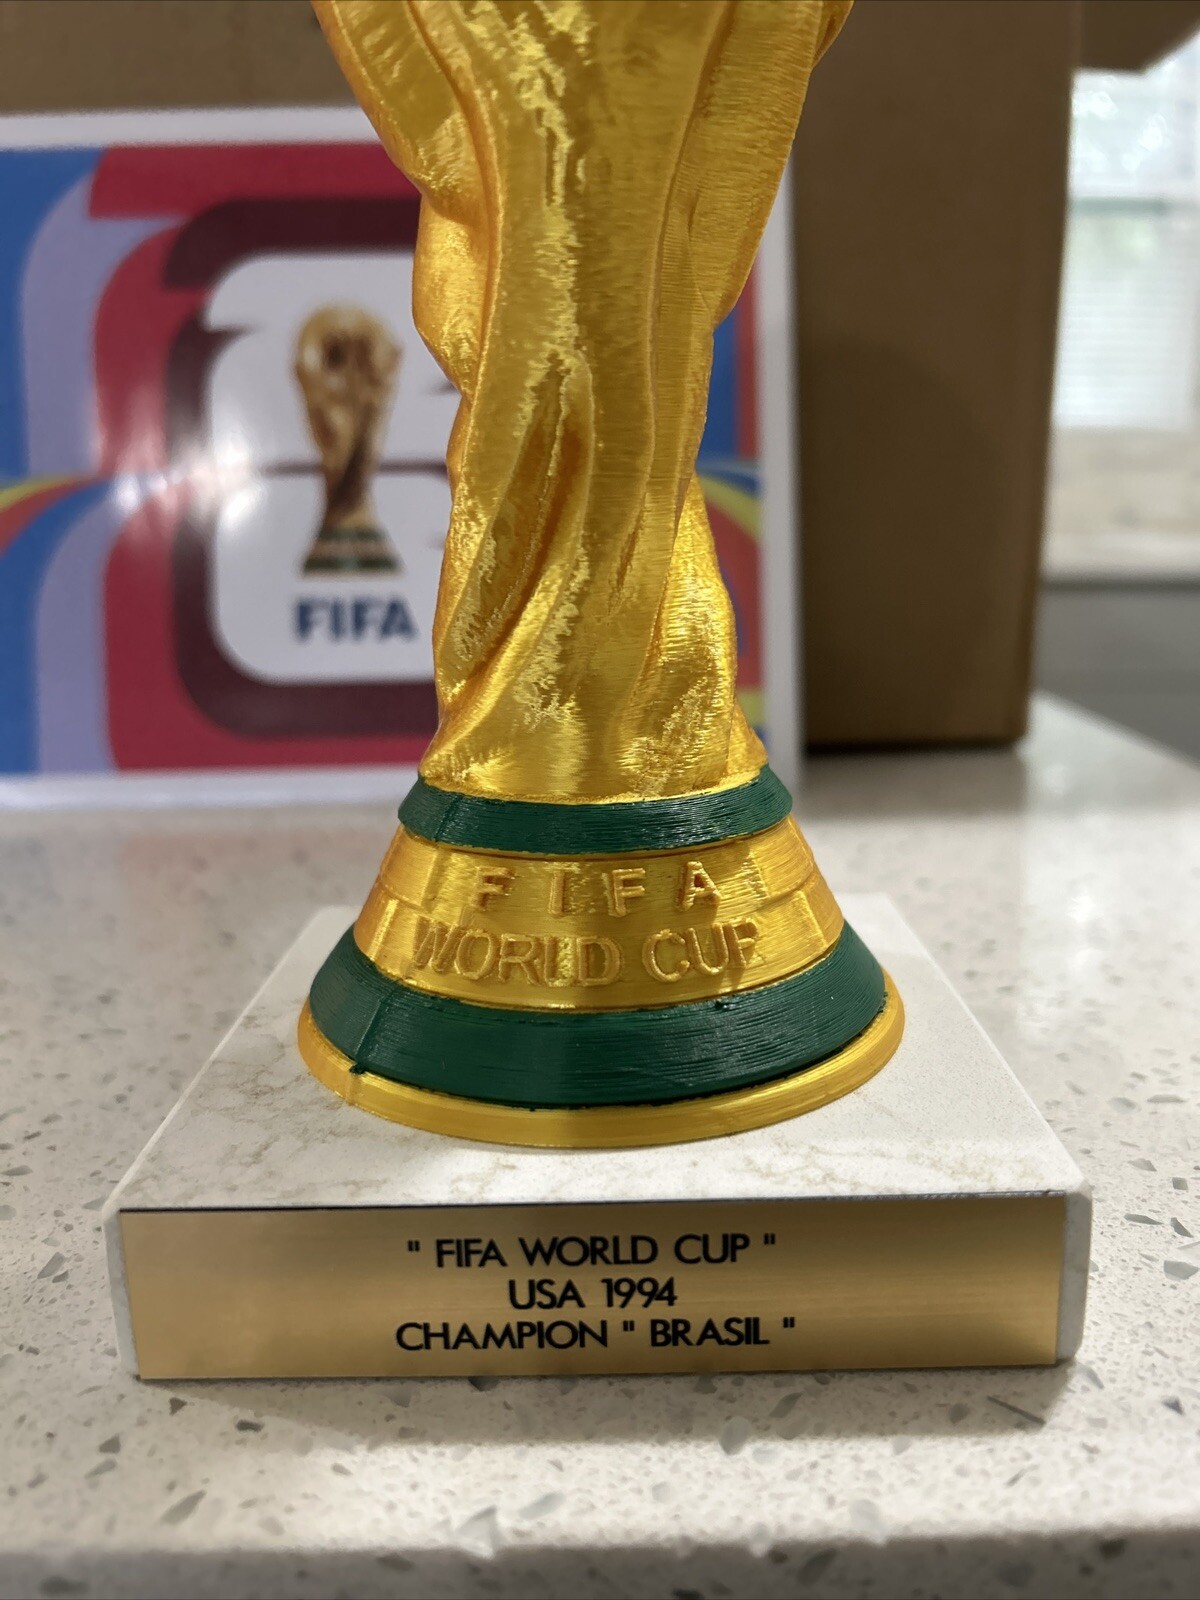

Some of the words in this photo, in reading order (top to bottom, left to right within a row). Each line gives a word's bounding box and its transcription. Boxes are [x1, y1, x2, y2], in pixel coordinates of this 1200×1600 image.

[295, 597, 417, 642] FIFA
[412, 915, 622, 987] WORLD
[642, 917, 759, 983] CUP
[436, 1239, 507, 1267] FIFA
[519, 1235, 658, 1266] WORLD
[674, 1233, 750, 1264] CUP
[509, 1279, 585, 1309] USA
[601, 1277, 677, 1308] 1994
[396, 1320, 608, 1351] CHAMPION
[651, 1317, 770, 1347] BRASIL
